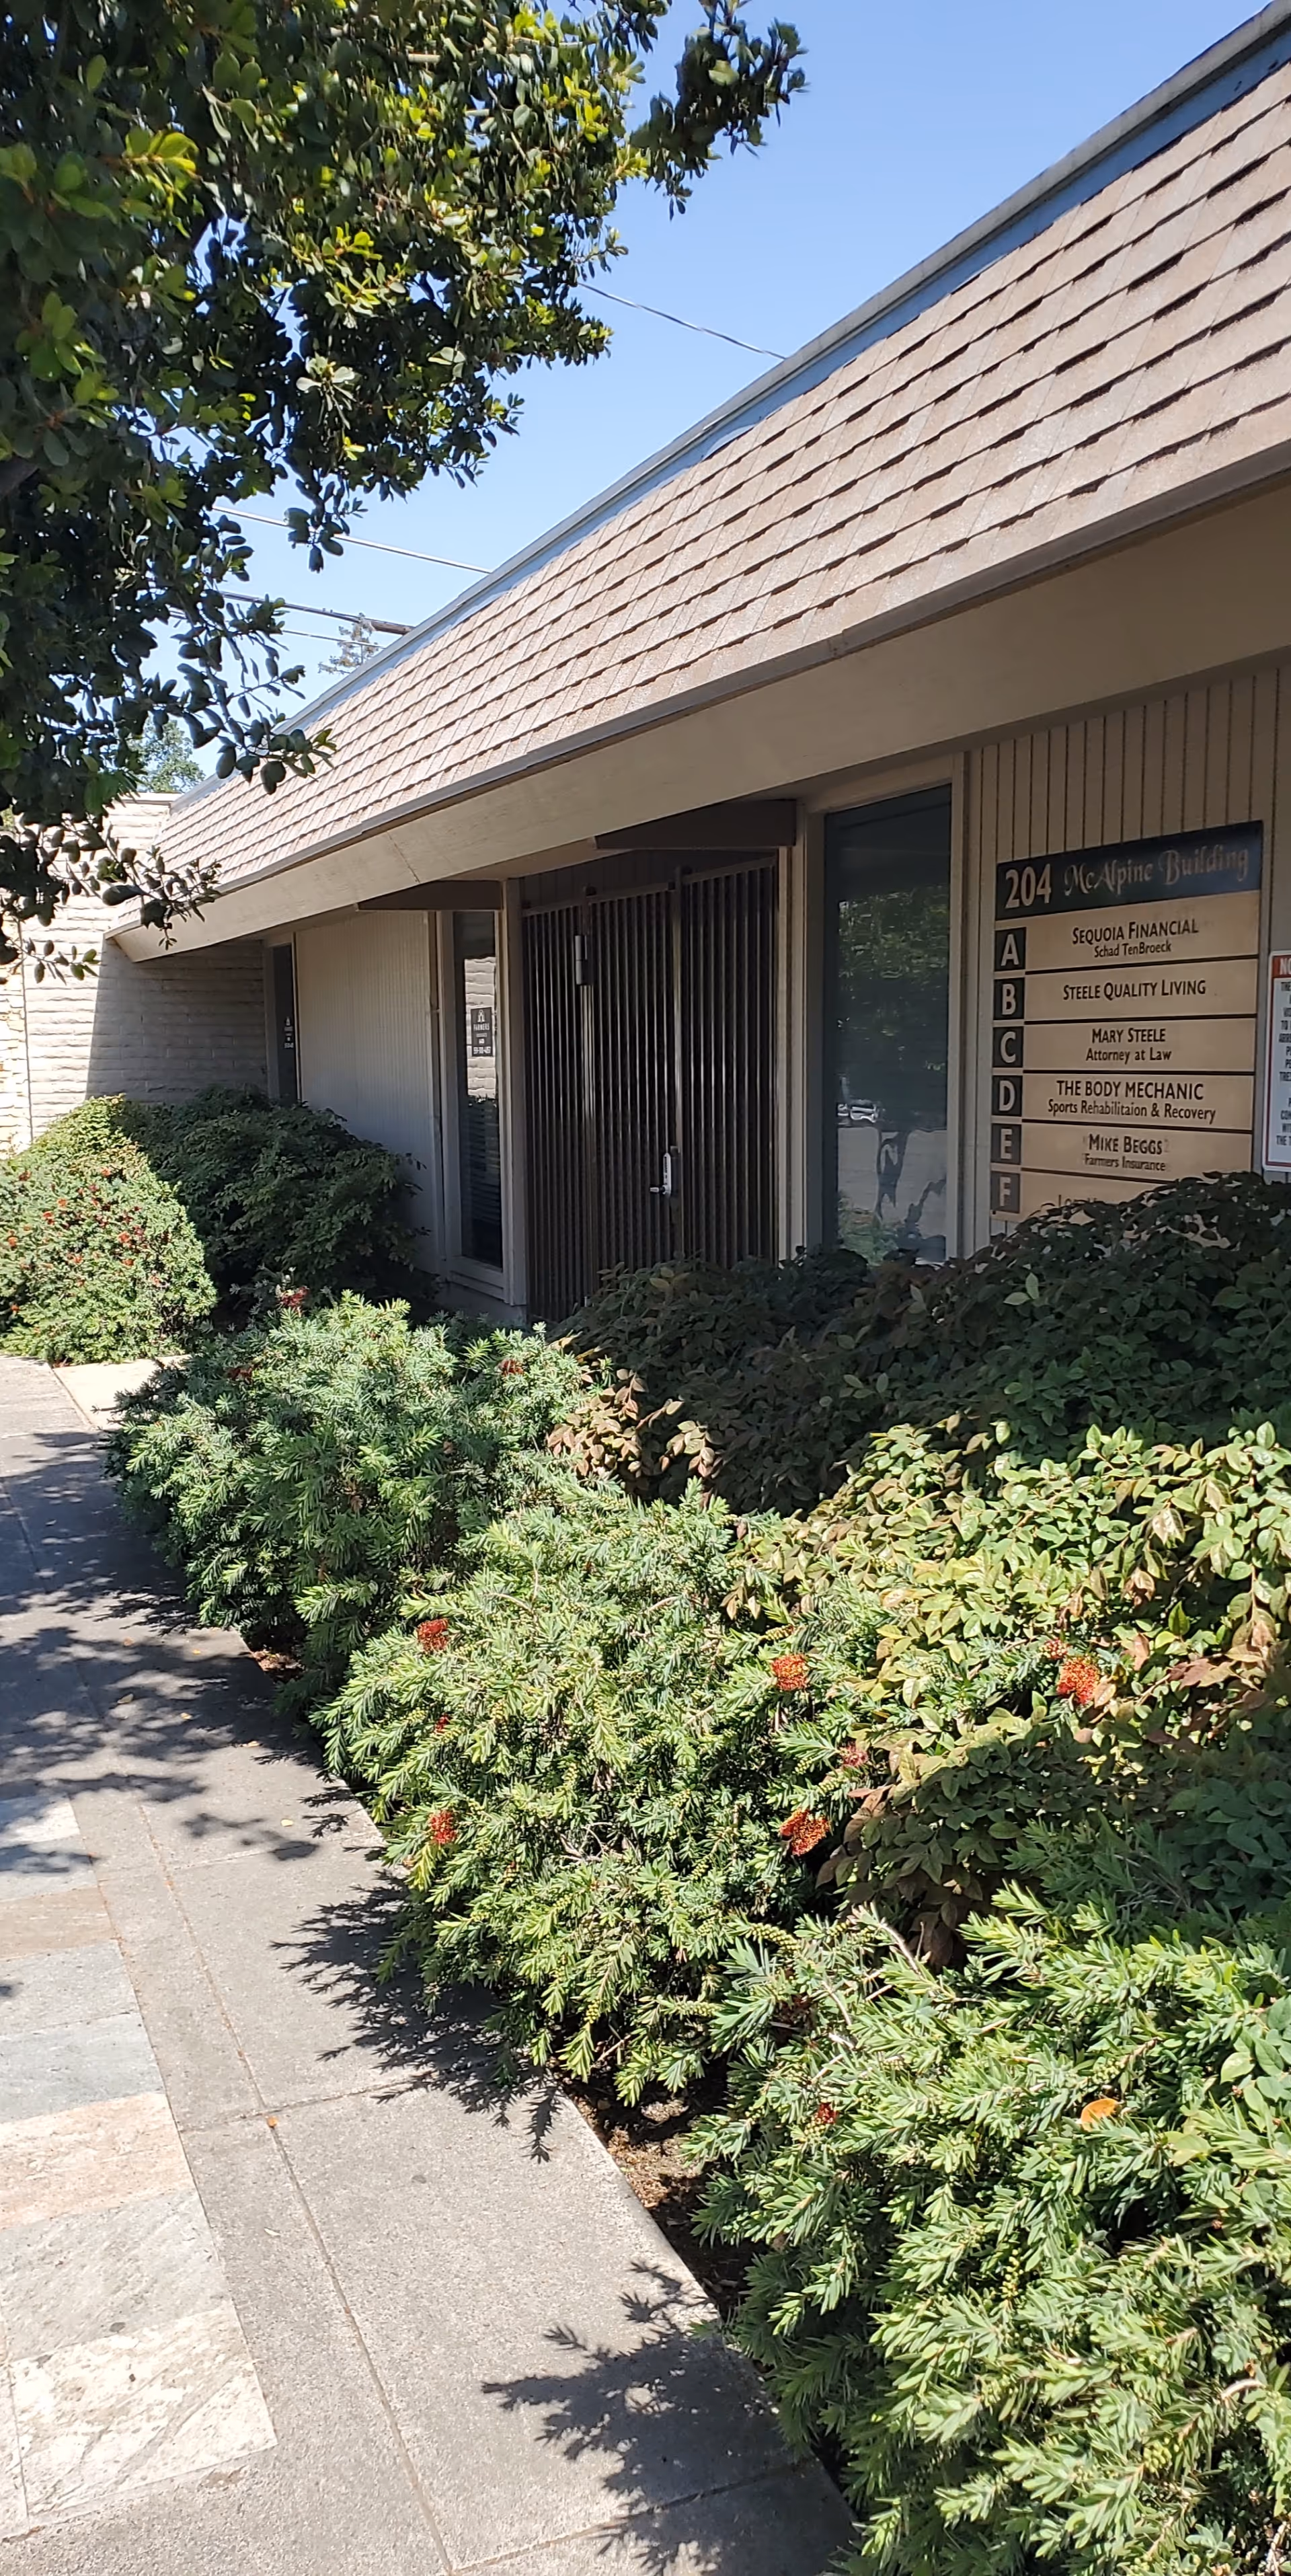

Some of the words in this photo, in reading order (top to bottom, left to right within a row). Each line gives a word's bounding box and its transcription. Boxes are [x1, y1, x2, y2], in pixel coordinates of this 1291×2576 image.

[1005, 864, 1052, 908] 204
[1064, 860, 1152, 896] McAlpine
[1159, 845, 1249, 885] Building
[1072, 926, 1125, 945] SEQUOIA
[1128, 919, 1199, 940] FINANCIAL
[1001, 934, 1019, 966] A
[1094, 943, 1120, 958] Schad
[1122, 940, 1171, 956] TenBroeck
[1001, 983, 1017, 1015] B
[1063, 985, 1101, 1000] STEELE
[1103, 981, 1158, 1001] QUALITY
[1161, 979, 1206, 996] LIVING
[1000, 1031, 1017, 1063] C
[1092, 1028, 1124, 1043] MARY
[1128, 1028, 1166, 1043] STEELE
[1085, 1048, 1130, 1065] Attorney
[1134, 1050, 1146, 1061] at
[1149, 1047, 1172, 1061] Law
[999, 1080, 1015, 1112] D
[1056, 1080, 1081, 1096] THE
[1085, 1081, 1121, 1097] BODY
[1125, 1082, 1204, 1100] MECHANIC
[1048, 1099, 1077, 1116] Sports
[1150, 1103, 1161, 1117] &
[1164, 1103, 1216, 1125] Recovery
[1000, 1129, 1012, 1160] E
[1089, 1134, 1119, 1152] MIKE
[1124, 1136, 1163, 1155] BEGGS
[1084, 1153, 1120, 1168] Farmers
[1122, 1156, 1166, 1171] Insurance
[999, 1177, 1011, 1208] F
